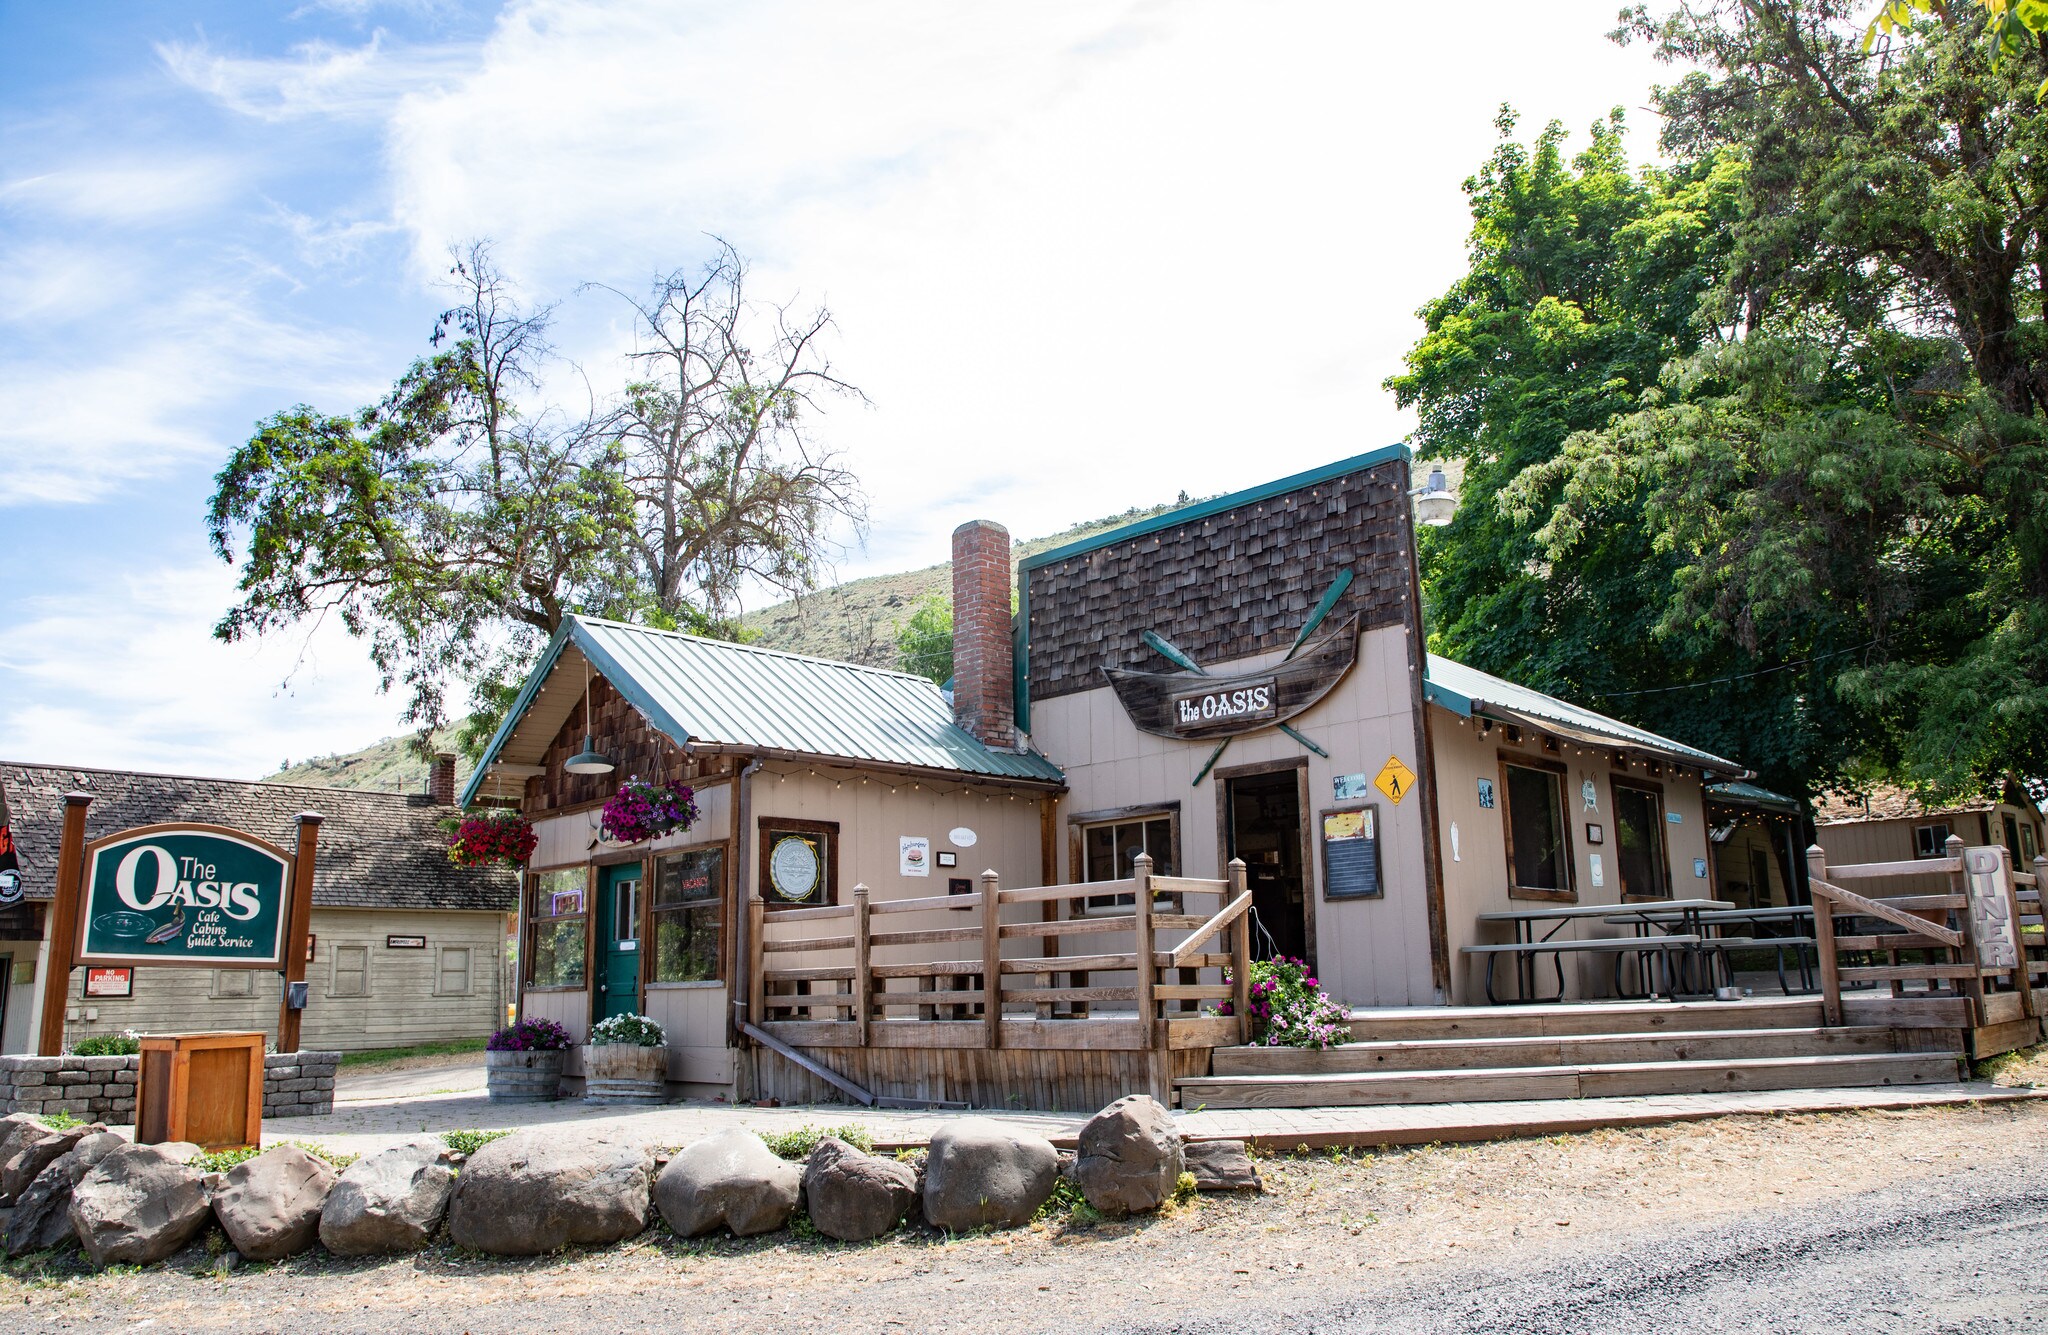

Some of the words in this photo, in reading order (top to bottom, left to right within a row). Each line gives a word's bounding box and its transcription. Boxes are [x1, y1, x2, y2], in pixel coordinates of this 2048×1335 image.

[1180, 700, 1199, 722] the
[1202, 686, 1269, 719] OASIS
[1334, 773, 1365, 783] WELCOME
[180, 856, 216, 880] The
[116, 845, 260, 920] OASIS
[682, 876, 709, 889] VACANCY
[1968, 850, 2015, 967] DINER
[198, 910, 220, 923] Cafe
[192, 922, 227, 935] Cabins
[187, 934, 216, 948] Guide
[218, 935, 253, 948] Service
